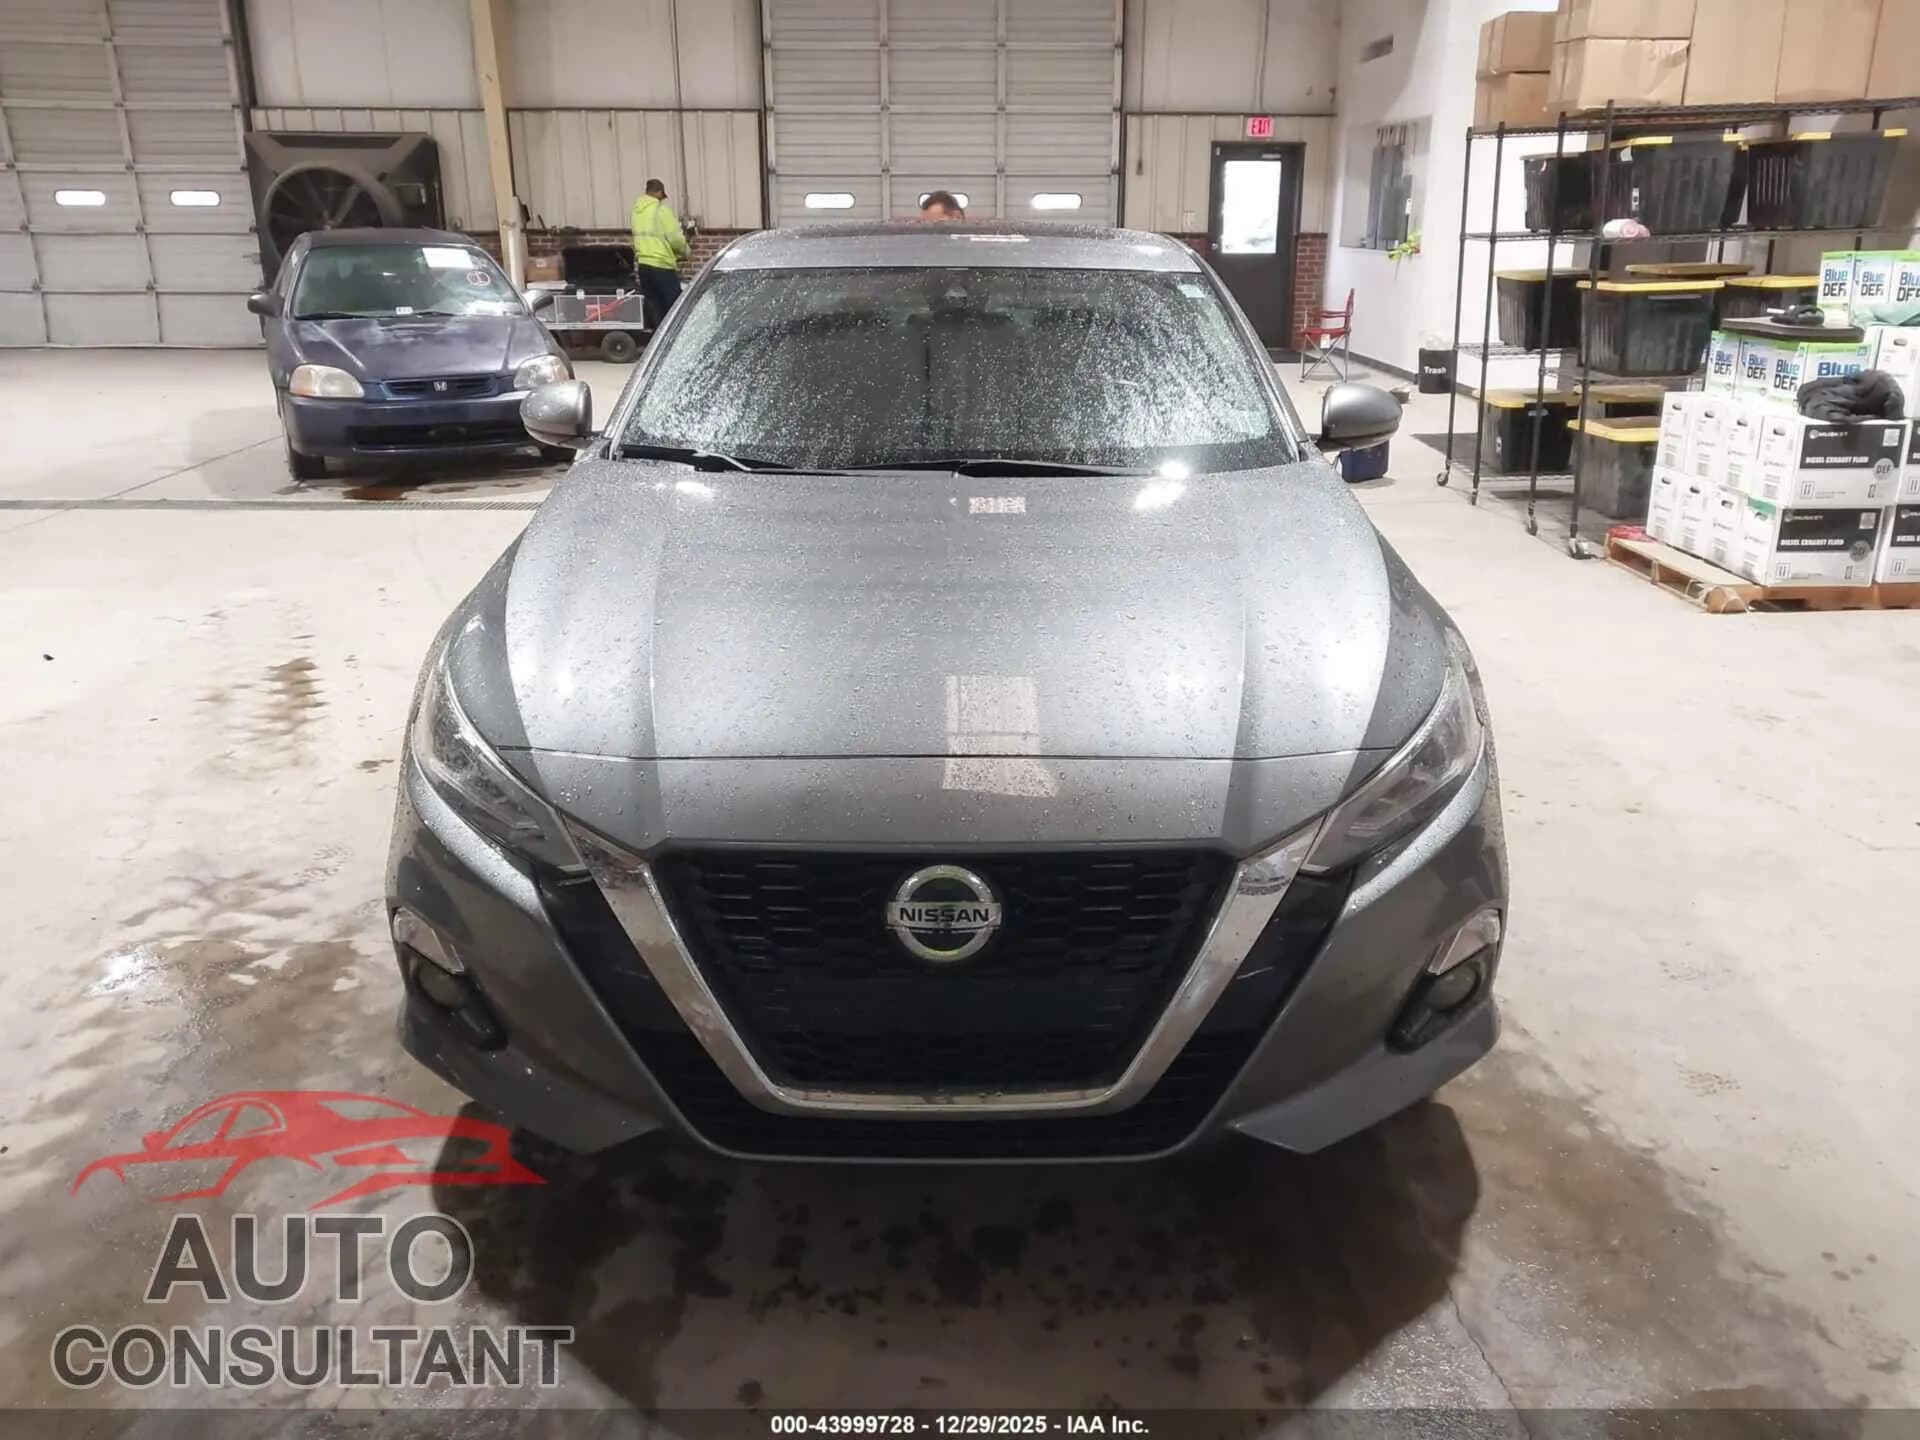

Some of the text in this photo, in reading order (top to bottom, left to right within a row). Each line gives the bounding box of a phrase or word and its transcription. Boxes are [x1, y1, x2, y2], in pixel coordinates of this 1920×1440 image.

[1251, 119, 1270, 135] EXIT
[1824, 268, 1848, 281] Blue
[1862, 271, 1885, 283] Blue
[1900, 272, 1920, 286] Blu
[1715, 350, 1733, 362] Blue
[1749, 354, 1768, 366] Blue
[1424, 366, 1447, 375] Trash
[1776, 359, 1800, 375] Blue
[1875, 464, 1891, 475] DEF
[900, 907, 989, 923] NISSAN
